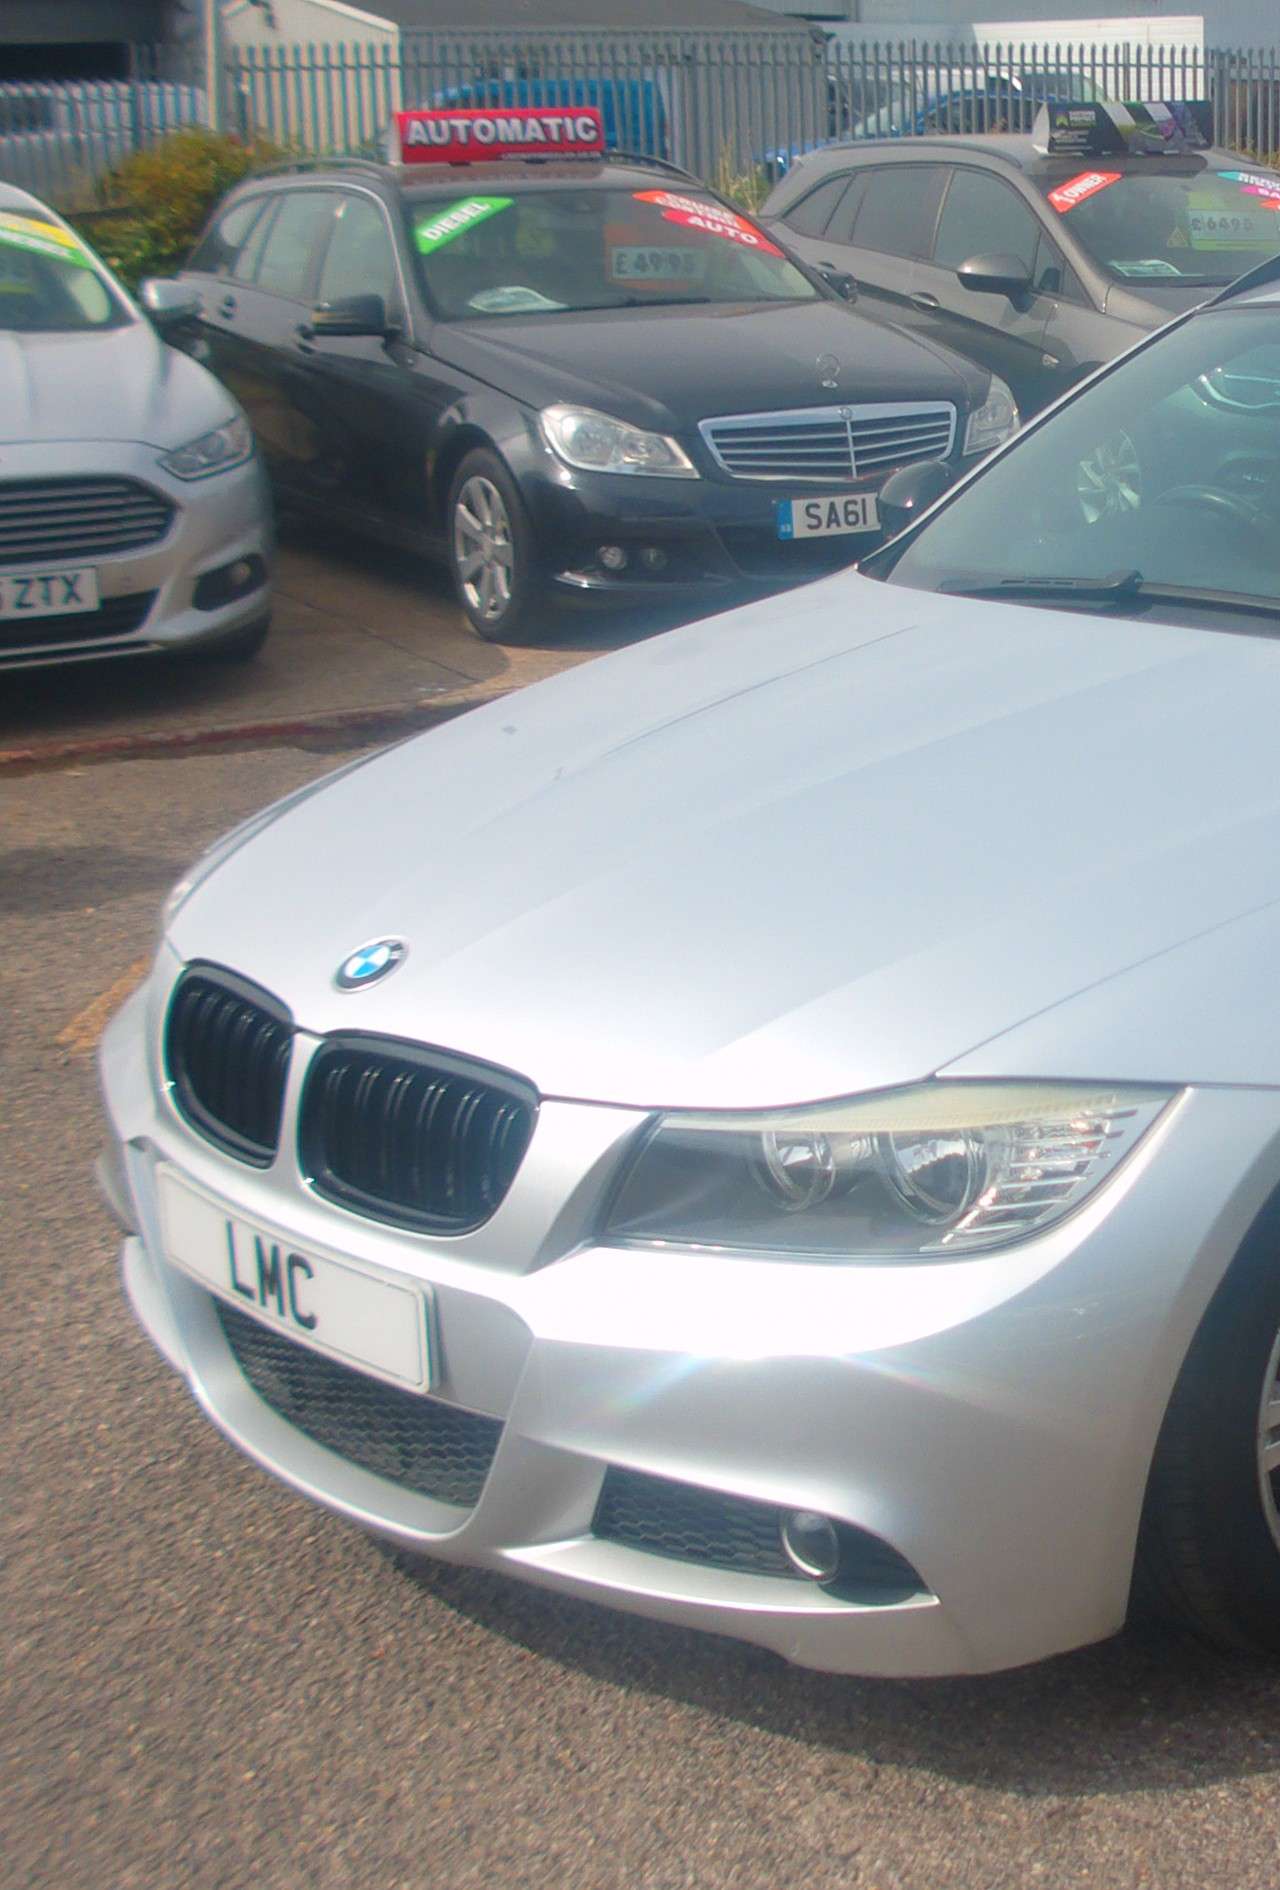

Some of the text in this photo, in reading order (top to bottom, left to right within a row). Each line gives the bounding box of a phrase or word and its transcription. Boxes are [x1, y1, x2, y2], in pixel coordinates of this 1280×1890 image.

[407, 117, 598, 145] AUTOMATIC
[422, 201, 492, 241] DIESEL
[687, 215, 759, 245] AUTO
[805, 497, 867, 531] SA61
[13, 574, 82, 609] ZTX
[225, 1218, 317, 1331] LMC
